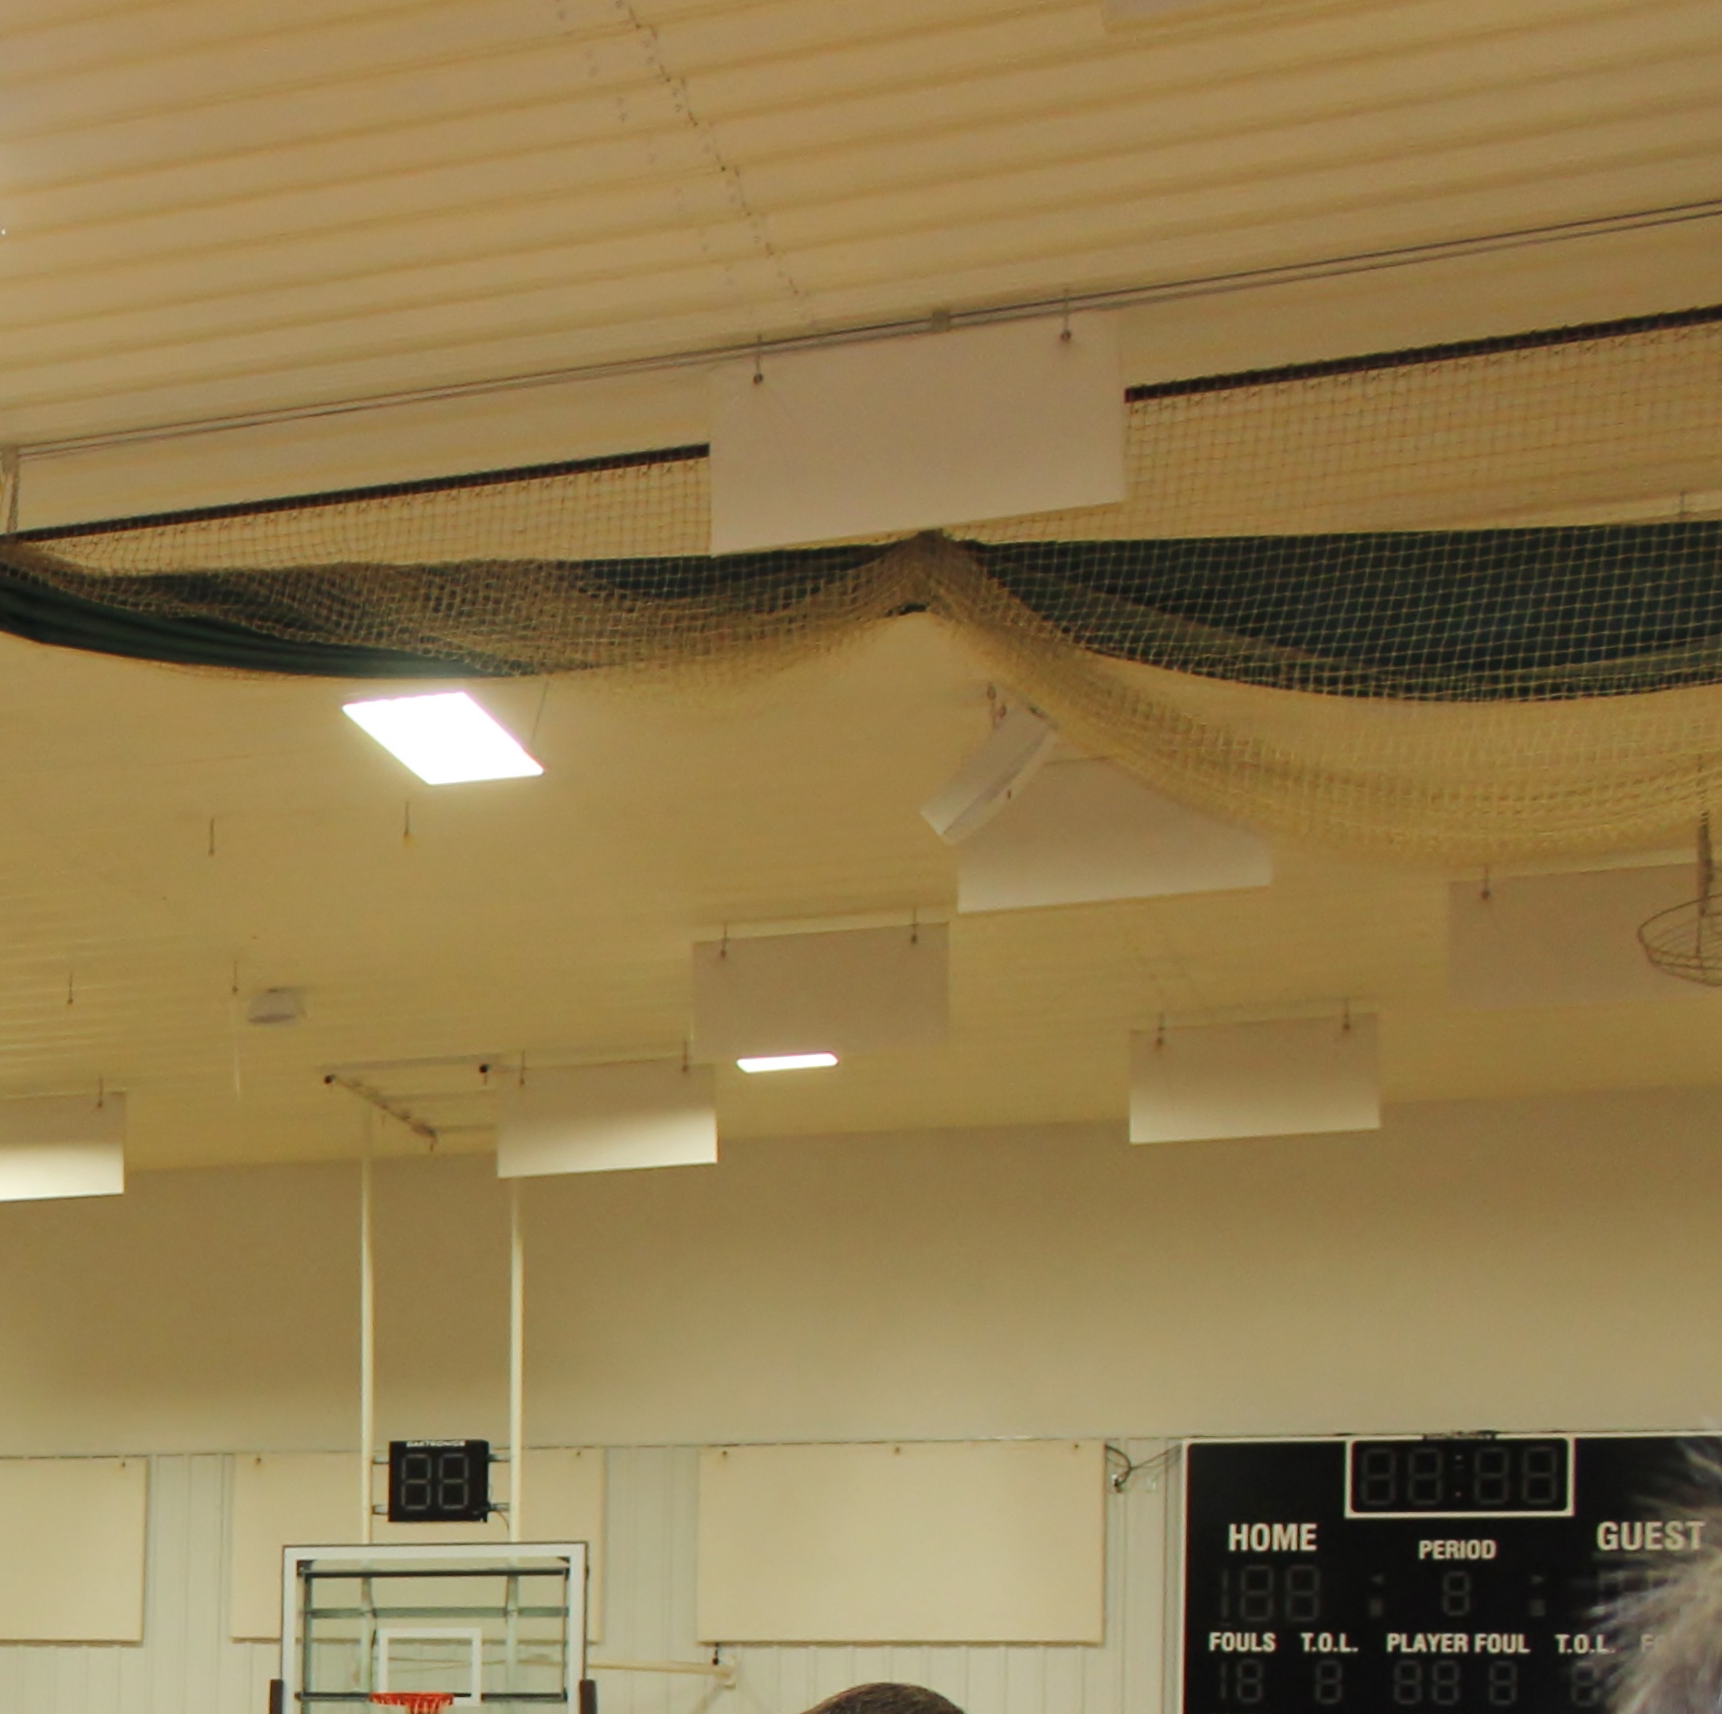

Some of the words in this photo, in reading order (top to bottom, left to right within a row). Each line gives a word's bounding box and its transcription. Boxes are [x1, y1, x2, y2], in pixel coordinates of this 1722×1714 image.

[1228, 1523, 1318, 1553] HOME
[1597, 1520, 1706, 1552] GUEST
[1418, 1539, 1496, 1560] PERIOD
[1208, 1632, 1277, 1653] FOULS
[1301, 1633, 1359, 1653] T.O.L.
[1386, 1633, 1469, 1654] PLAYER
[1474, 1634, 1531, 1655] FOUL
